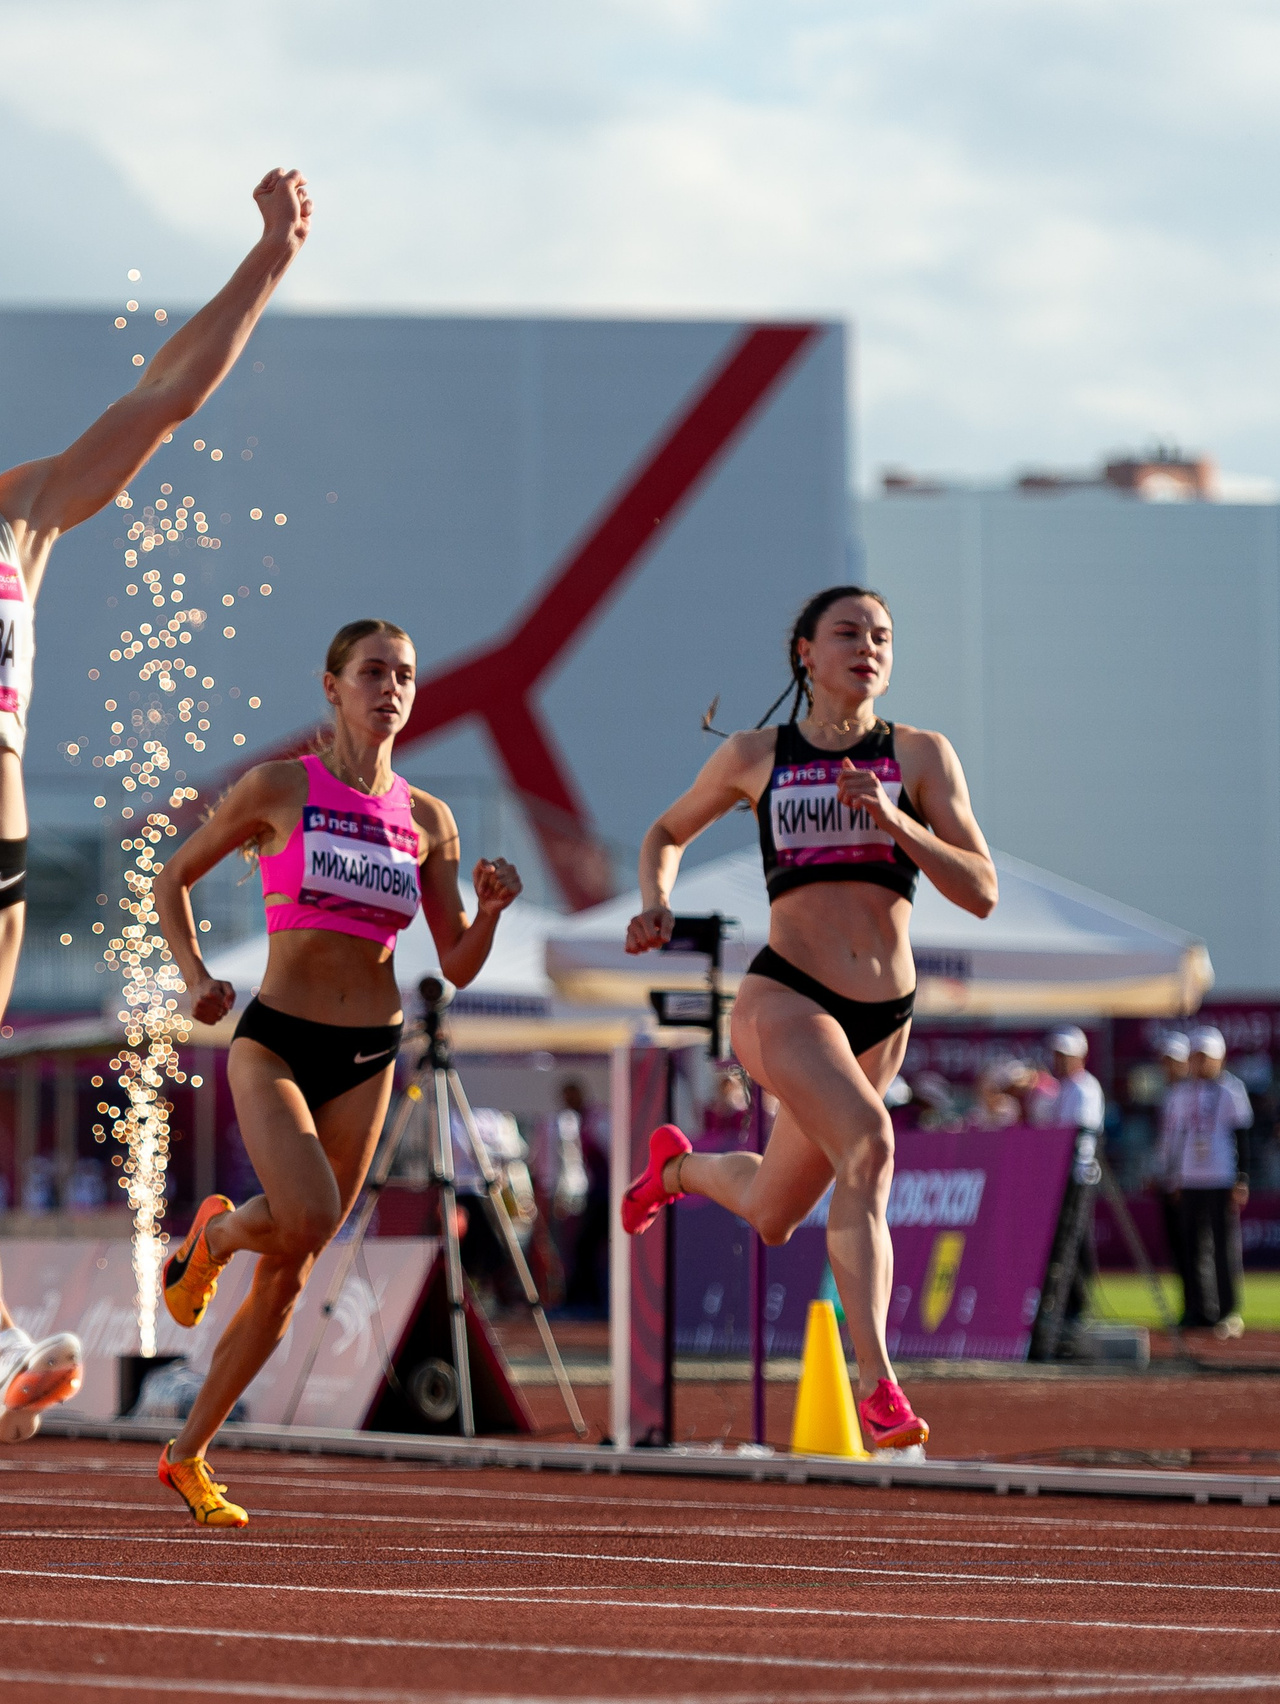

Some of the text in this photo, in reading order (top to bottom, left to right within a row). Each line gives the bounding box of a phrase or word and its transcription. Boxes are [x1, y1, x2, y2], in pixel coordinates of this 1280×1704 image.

[795, 768, 827, 781] ПСБ
[328, 817, 359, 833] ПСБ
[312, 850, 418, 902] МИХАЙЛОВИЧ
